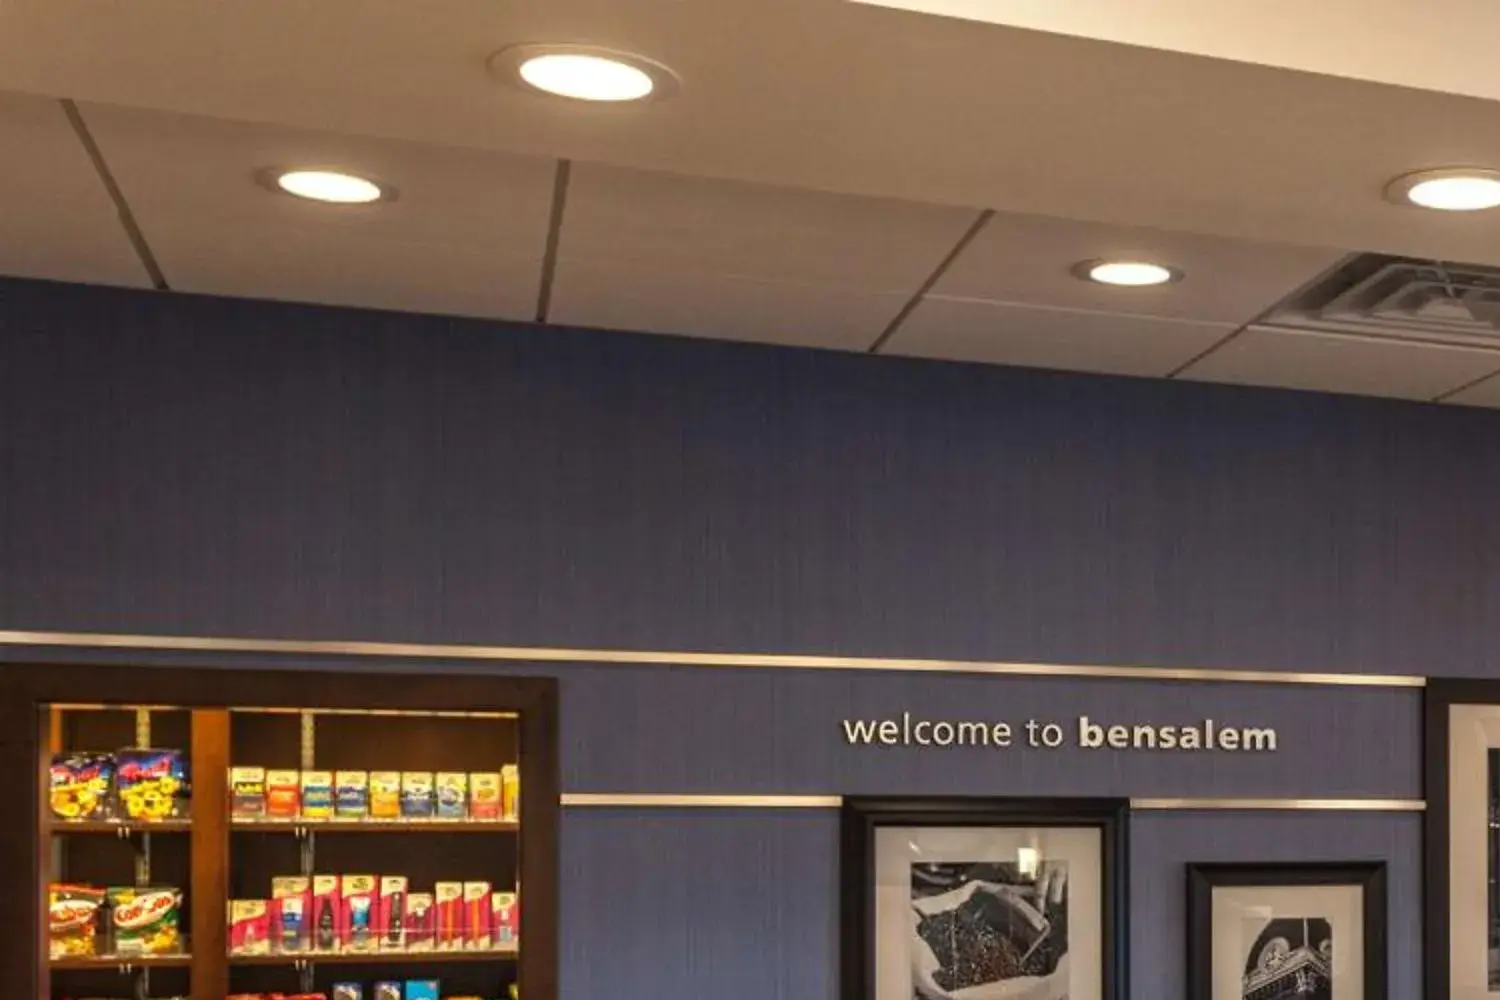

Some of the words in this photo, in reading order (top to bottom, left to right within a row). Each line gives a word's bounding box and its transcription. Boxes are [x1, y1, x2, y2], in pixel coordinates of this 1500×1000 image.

[843, 711, 1012, 746] welcome
[1025, 719, 1064, 747] to
[1079, 716, 1277, 750] bensalem
